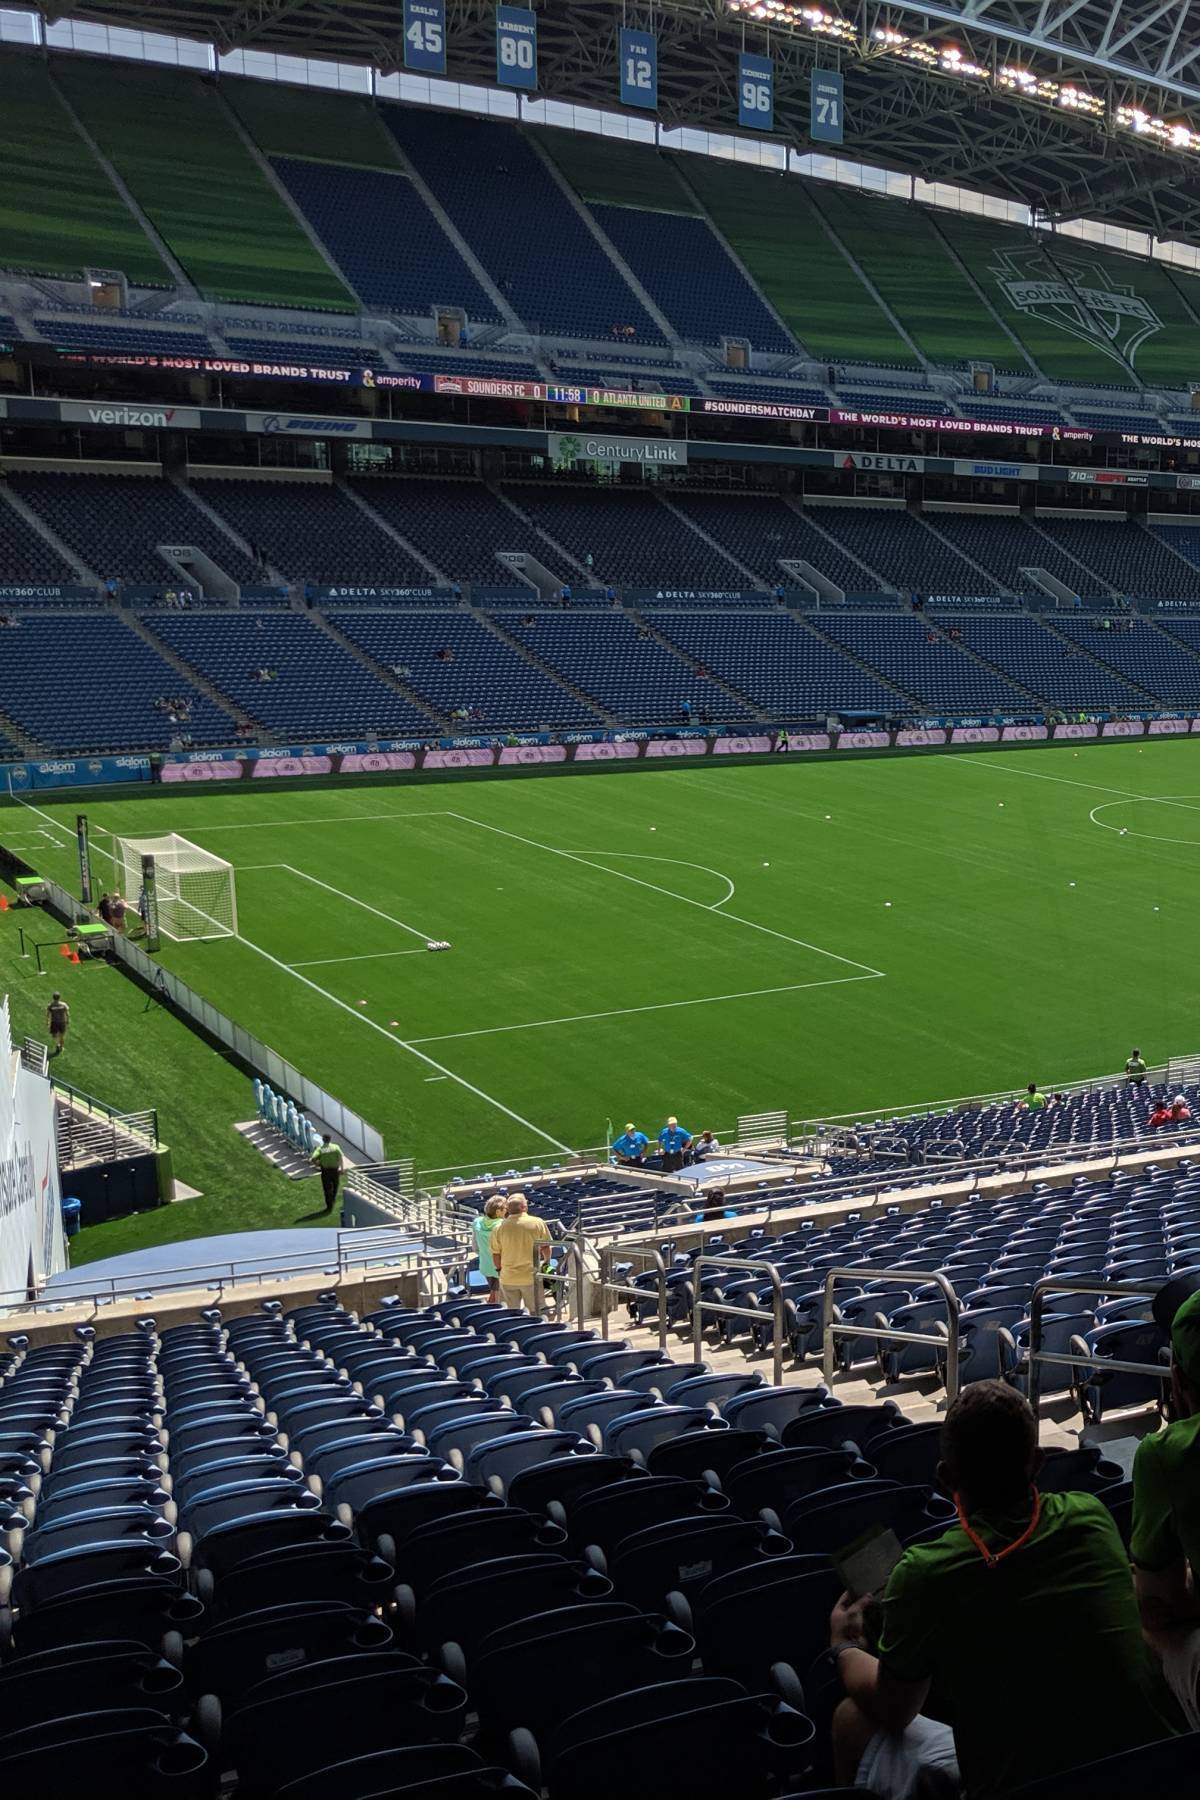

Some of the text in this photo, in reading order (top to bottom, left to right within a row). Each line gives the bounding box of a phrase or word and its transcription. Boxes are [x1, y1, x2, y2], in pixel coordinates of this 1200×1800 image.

[409, 4, 439, 17] EASLEY
[498, 21, 535, 35] LARGENT
[406, 20, 442, 53] 45
[501, 37, 534, 69] 80
[629, 44, 648, 55] FAN
[626, 58, 652, 89] 12
[742, 82, 771, 112] 96
[815, 98, 839, 126] 71
[162, 356, 201, 369] MOST
[205, 360, 250, 374] LOVED
[253, 363, 308, 378] BRANDS
[310, 368, 351, 381] TRUST
[376, 374, 422, 390] amperity
[467, 380, 513, 396] SOUNDERS
[513, 384, 526, 397] FC
[533, 386, 541, 398] 0
[553, 387, 581, 402] 11:58
[592, 391, 666, 408] 0 ATLANTA UNITED
[704, 400, 816, 420] #SOUNDERSMATCHDAY
[88, 407, 167, 427] verizon
[837, 411, 1044, 436] THE WORLD'S MOST LOVED BRANDS TRUST
[285, 419, 358, 432] BOEING
[1063, 431, 1094, 442] amperity
[1121, 434, 1139, 444] THE
[1141, 436, 1182, 447] WORLD'S
[585, 441, 678, 461] CenturyLink
[861, 456, 918, 471] DELTA
[974, 464, 1021, 477] BUD LIGHT
[340, 587, 377, 596] DELTA
[665, 591, 695, 599] DELTA
[936, 595, 962, 603] DELTA
[453, 737, 481, 748] slalom
[566, 733, 593, 743] slalom
[326, 744, 357, 754] slalom
[390, 740, 421, 750] slalom
[189, 752, 224, 762] slalom
[259, 749, 291, 759] slalom
[39, 761, 76, 774] slalom
[115, 756, 150, 768] slalom
